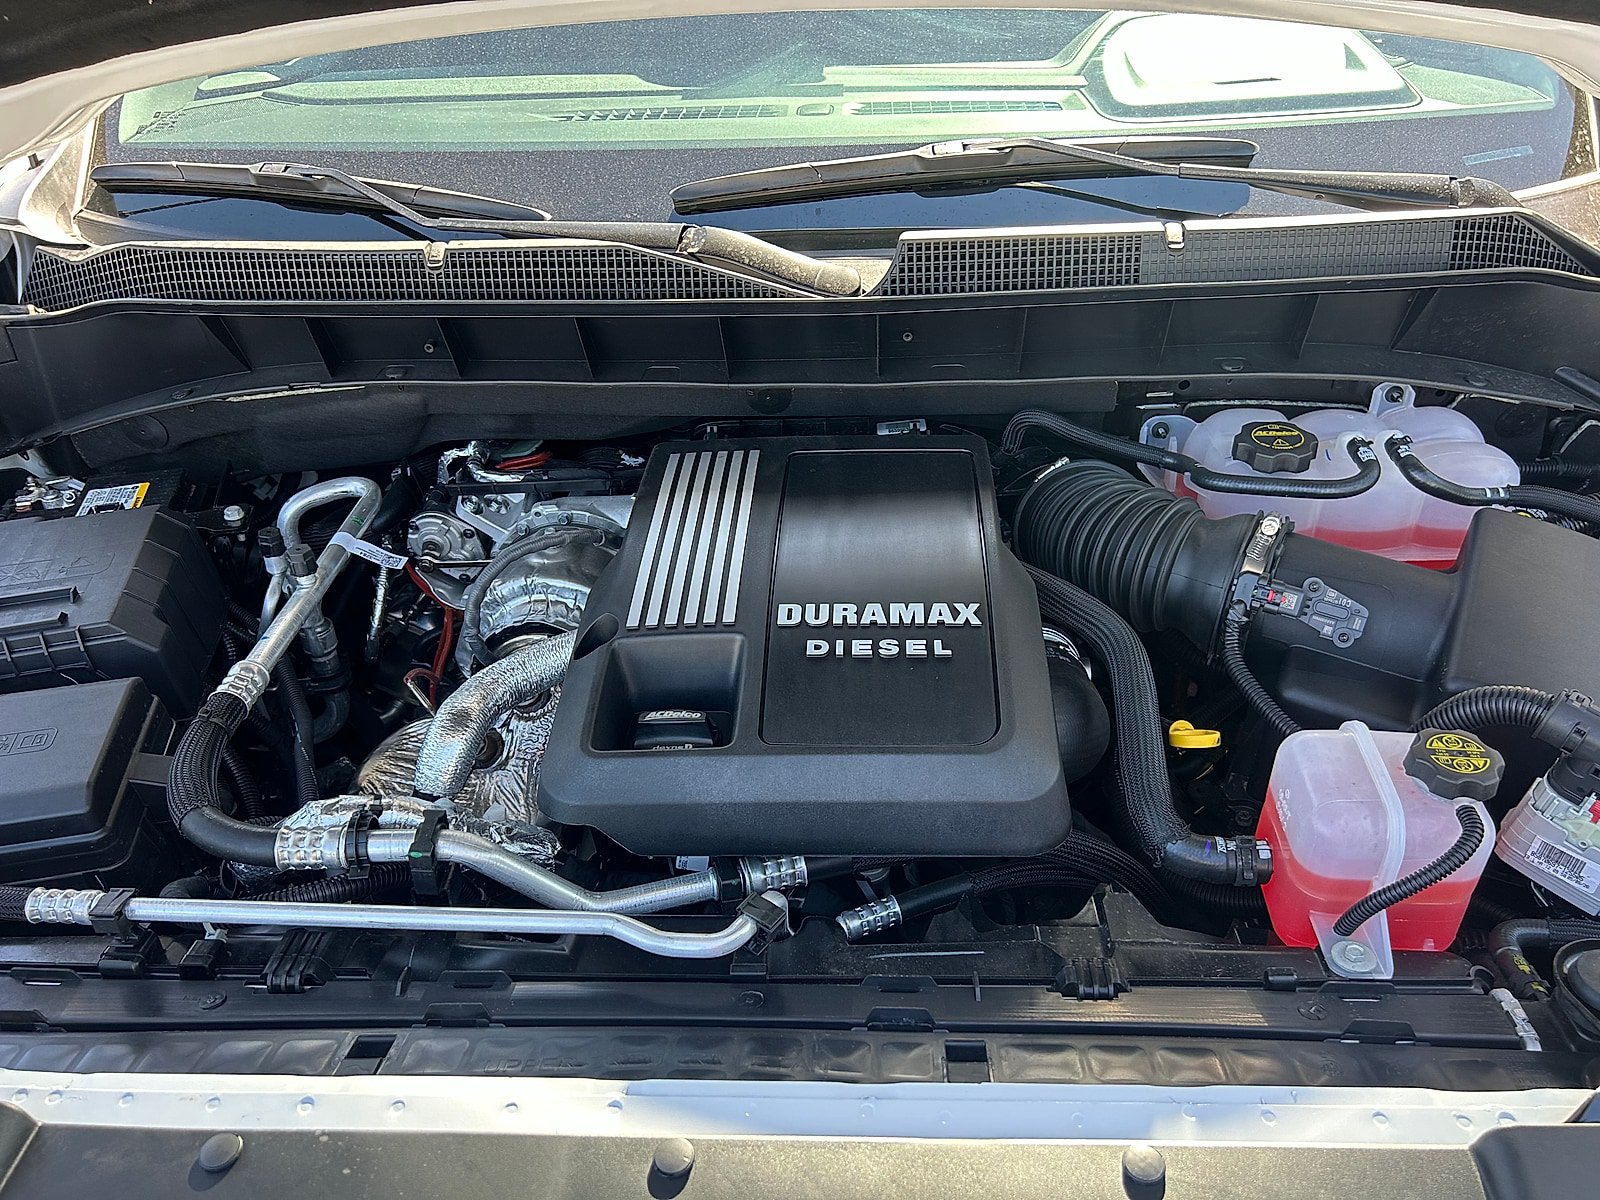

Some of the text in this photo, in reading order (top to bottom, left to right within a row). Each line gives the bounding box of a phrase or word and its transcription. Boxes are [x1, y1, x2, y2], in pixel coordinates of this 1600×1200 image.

[777, 602, 983, 627] DURAMAX
[806, 639, 953, 658] DIESEL
[644, 710, 702, 720] ACDelco
